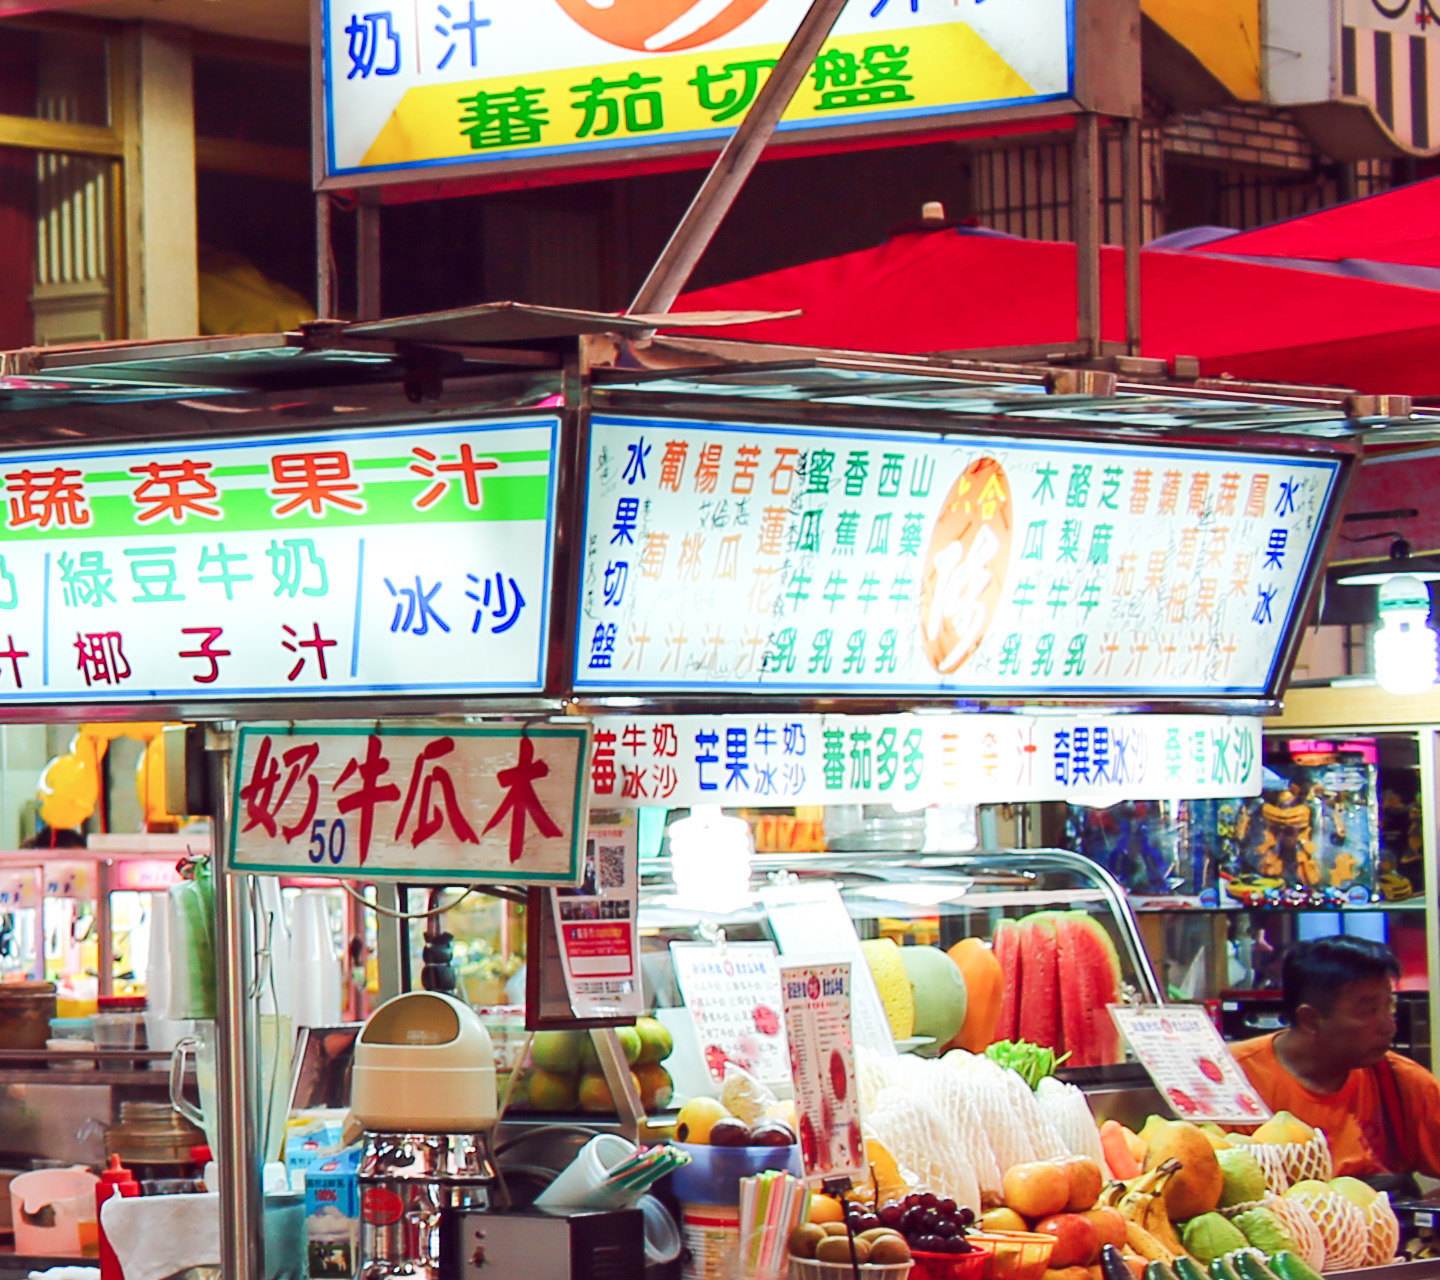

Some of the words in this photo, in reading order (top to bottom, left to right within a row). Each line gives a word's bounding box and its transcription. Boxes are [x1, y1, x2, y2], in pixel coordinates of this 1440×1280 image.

[459, 43, 916, 151] 蕃茄切盤
[57, 538, 330, 608] 綠豆牛奶
[384, 571, 526, 637] 冰沙
[74, 622, 338, 687] 椰子汁
[588, 435, 652, 670] 水果切盤
[622, 440, 689, 672] 葡萄汁
[659, 442, 724, 672] 楊桃汁
[697, 444, 762, 673] 苦瓜汁
[735, 447, 801, 673] 石蓮花汁
[771, 448, 837, 674] 蜜瓜牛乳
[807, 450, 870, 674] 香蕉牛乳
[842, 452, 906, 674] 西瓜牛乳
[874, 454, 937, 674] 山藥牛乳
[997, 461, 1060, 677] 木瓜牛乳
[1030, 463, 1093, 677] 酪梨牛乳
[1062, 465, 1124, 677] 芝麻牛乳
[1252, 474, 1302, 625] 水果冰
[308, 818, 348, 865] 50
[621, 763, 679, 799] 冰沙
[622, 723, 678, 757] 牛奶
[695, 727, 750, 791] 芒果
[754, 723, 807, 757] 牛奶
[754, 763, 807, 796] 冰沙
[823, 726, 924, 791] 蕃茄多多
